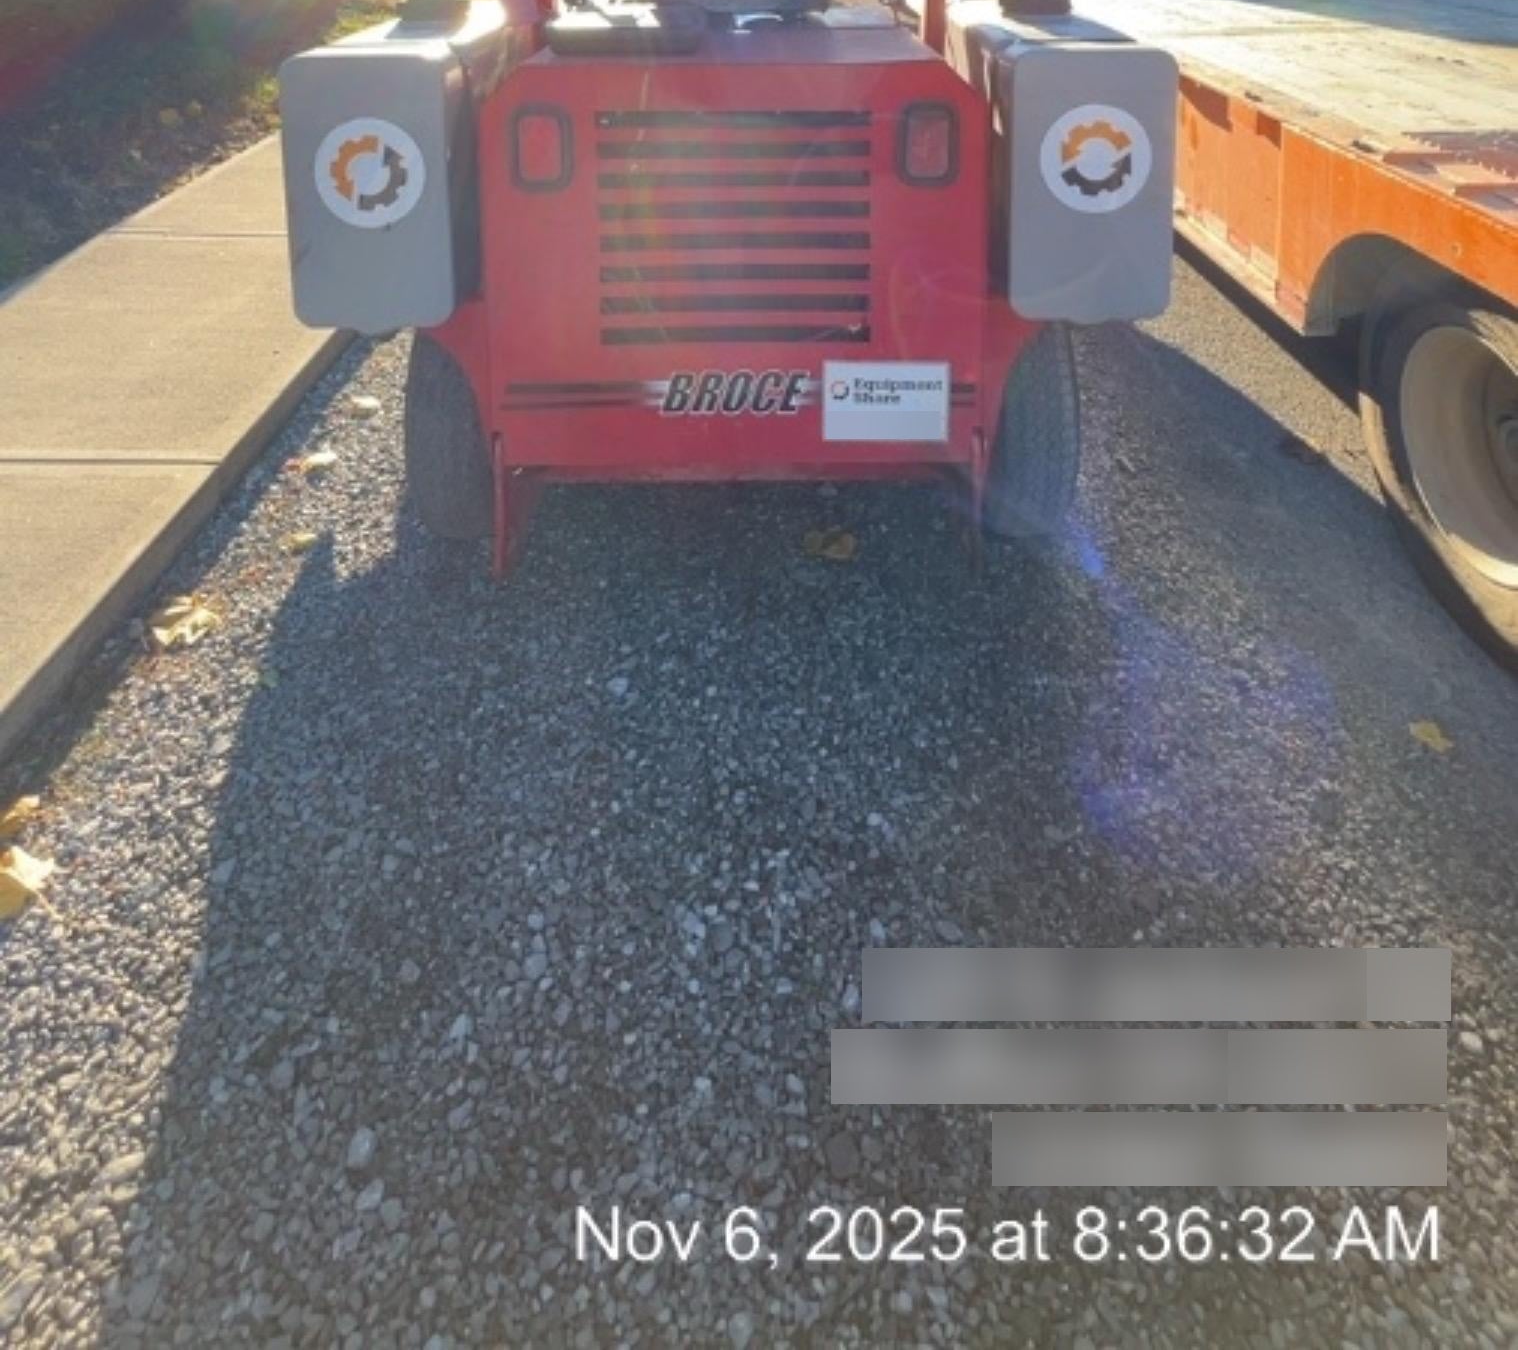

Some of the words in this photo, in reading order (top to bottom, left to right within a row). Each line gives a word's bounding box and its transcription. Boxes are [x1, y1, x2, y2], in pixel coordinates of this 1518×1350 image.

[661, 369, 811, 415] BROCE
[852, 377, 944, 393] Equipment
[852, 392, 903, 405] Share
